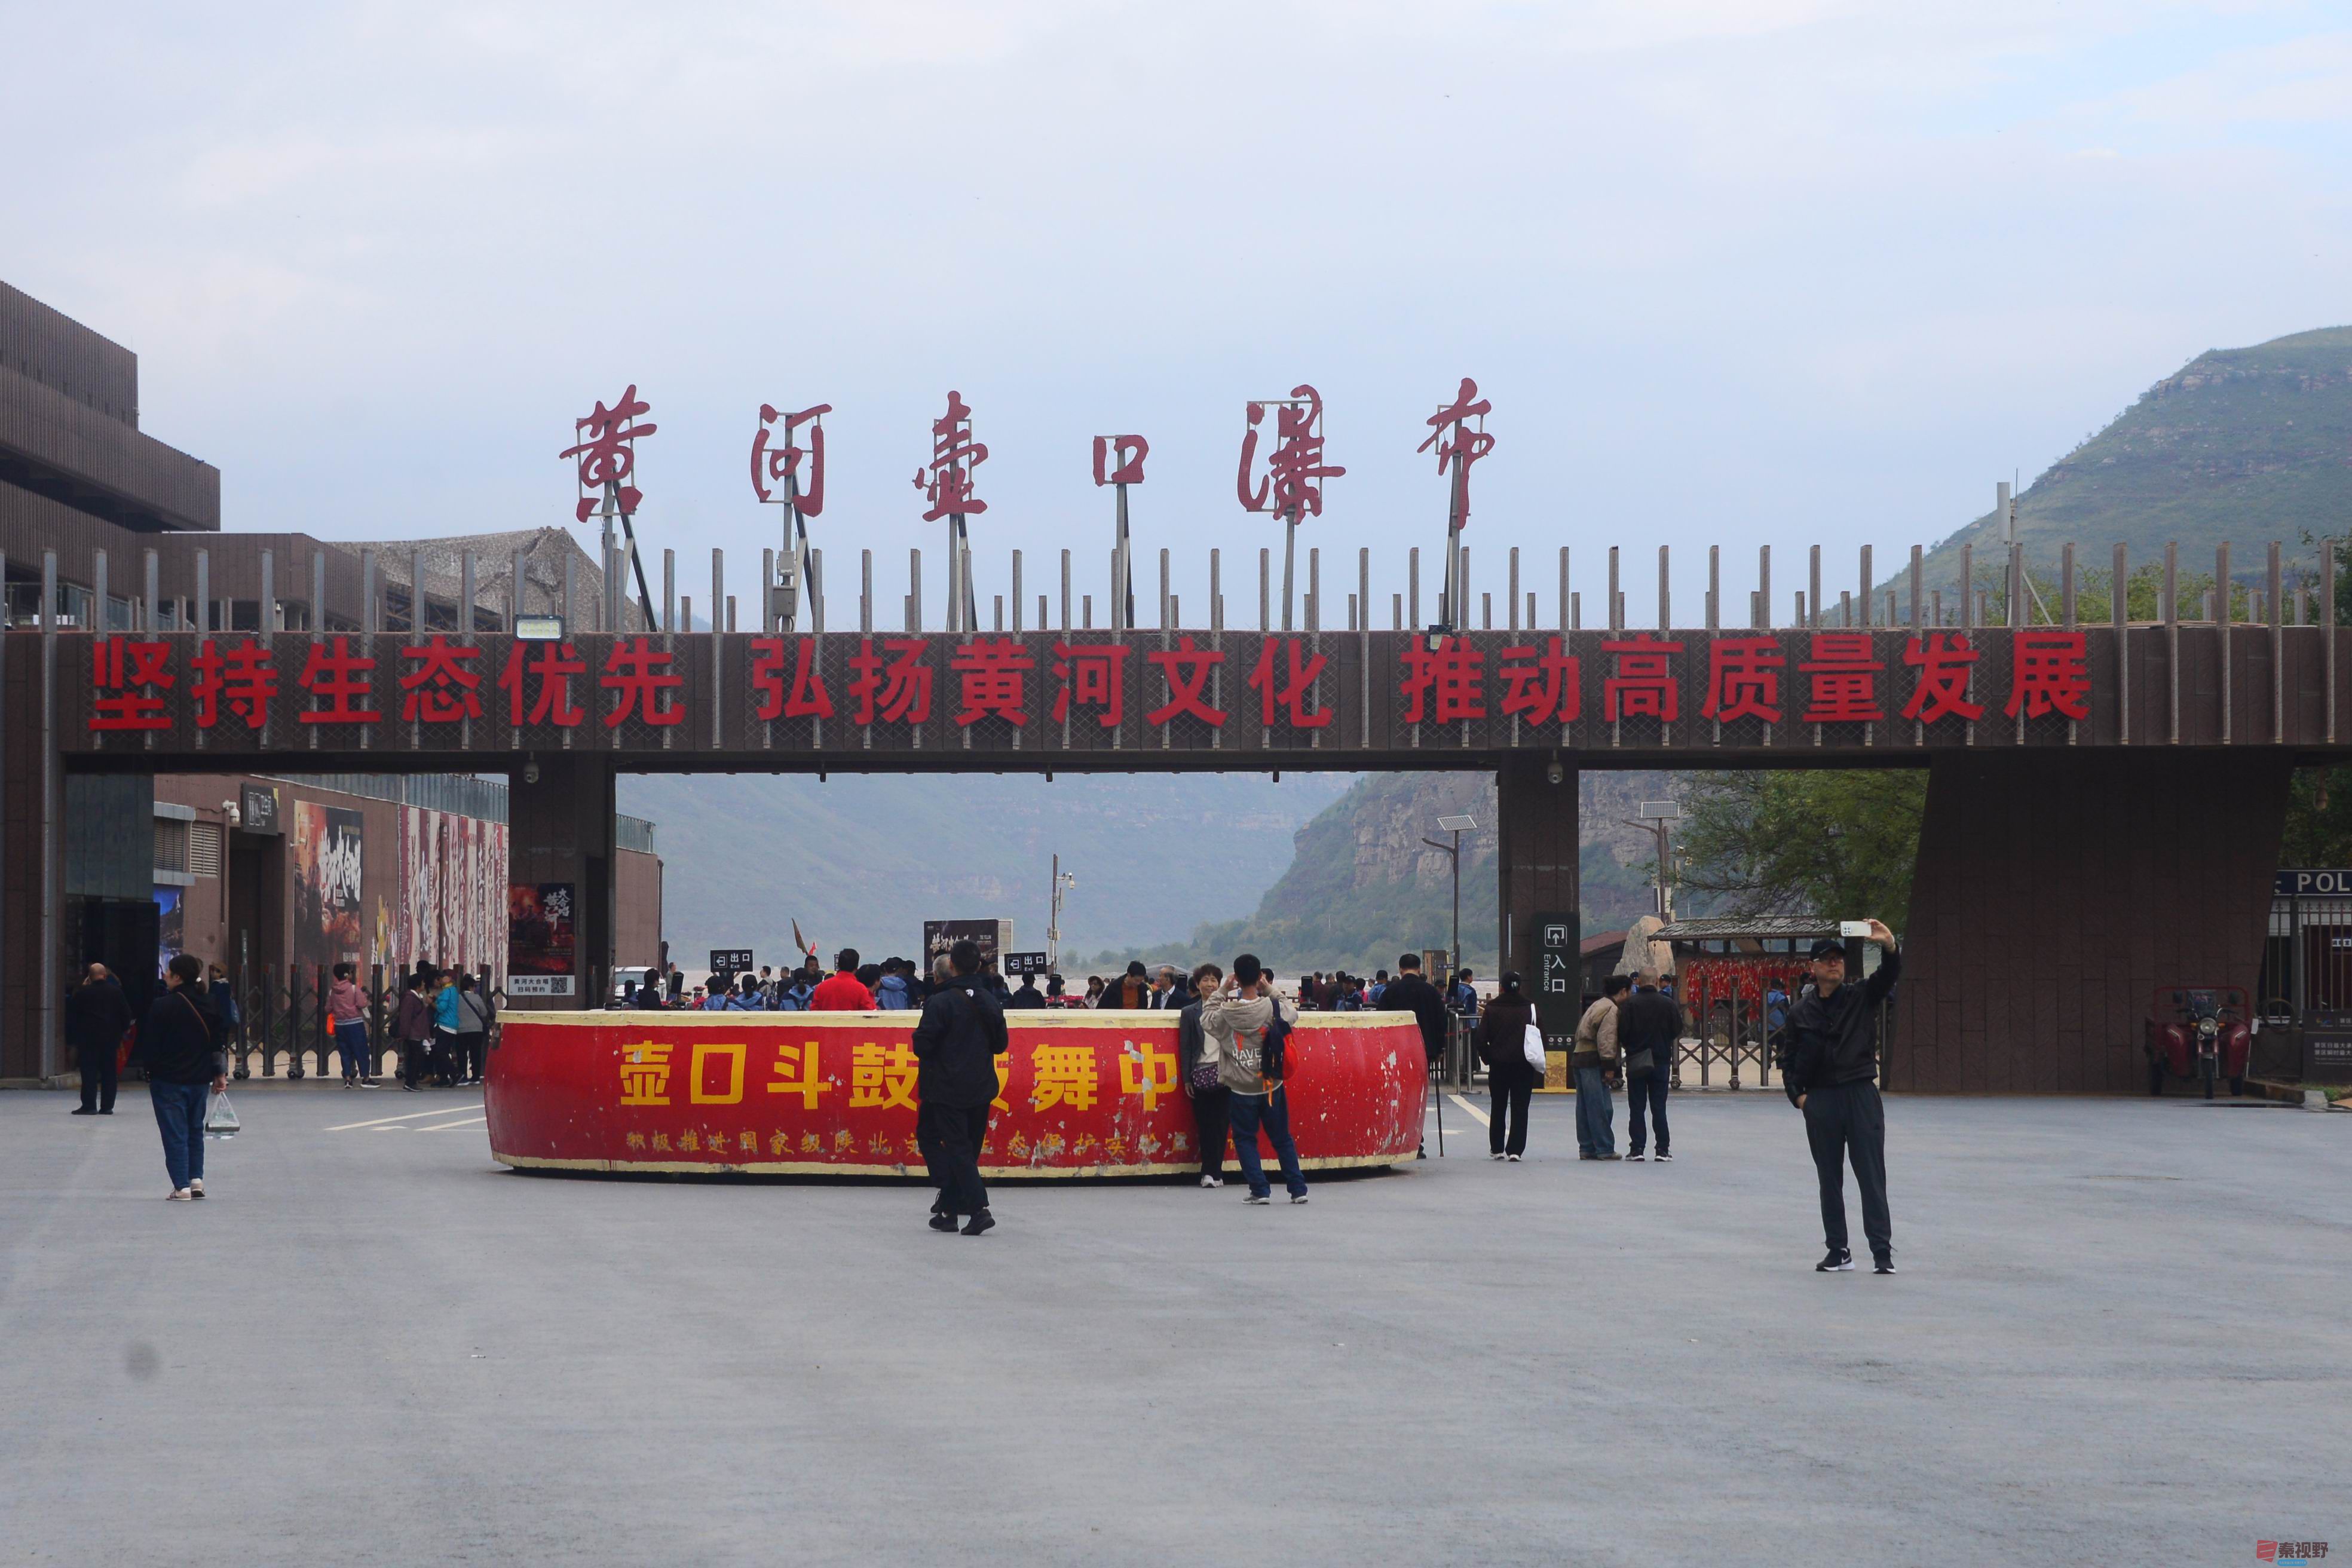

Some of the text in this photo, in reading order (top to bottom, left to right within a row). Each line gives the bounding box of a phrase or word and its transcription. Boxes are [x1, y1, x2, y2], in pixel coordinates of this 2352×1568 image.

[559, 378, 1495, 529] 黄河壶口瀑布
[88, 632, 2091, 730] 坚持生态优先 弘扬黄河文化 推动高质量发展
[730, 953, 750, 962] 出口
[1024, 956, 1043, 964] 出口
[1551, 954, 1566, 993] 入口
[1232, 1048, 1262, 1060] HAVE
